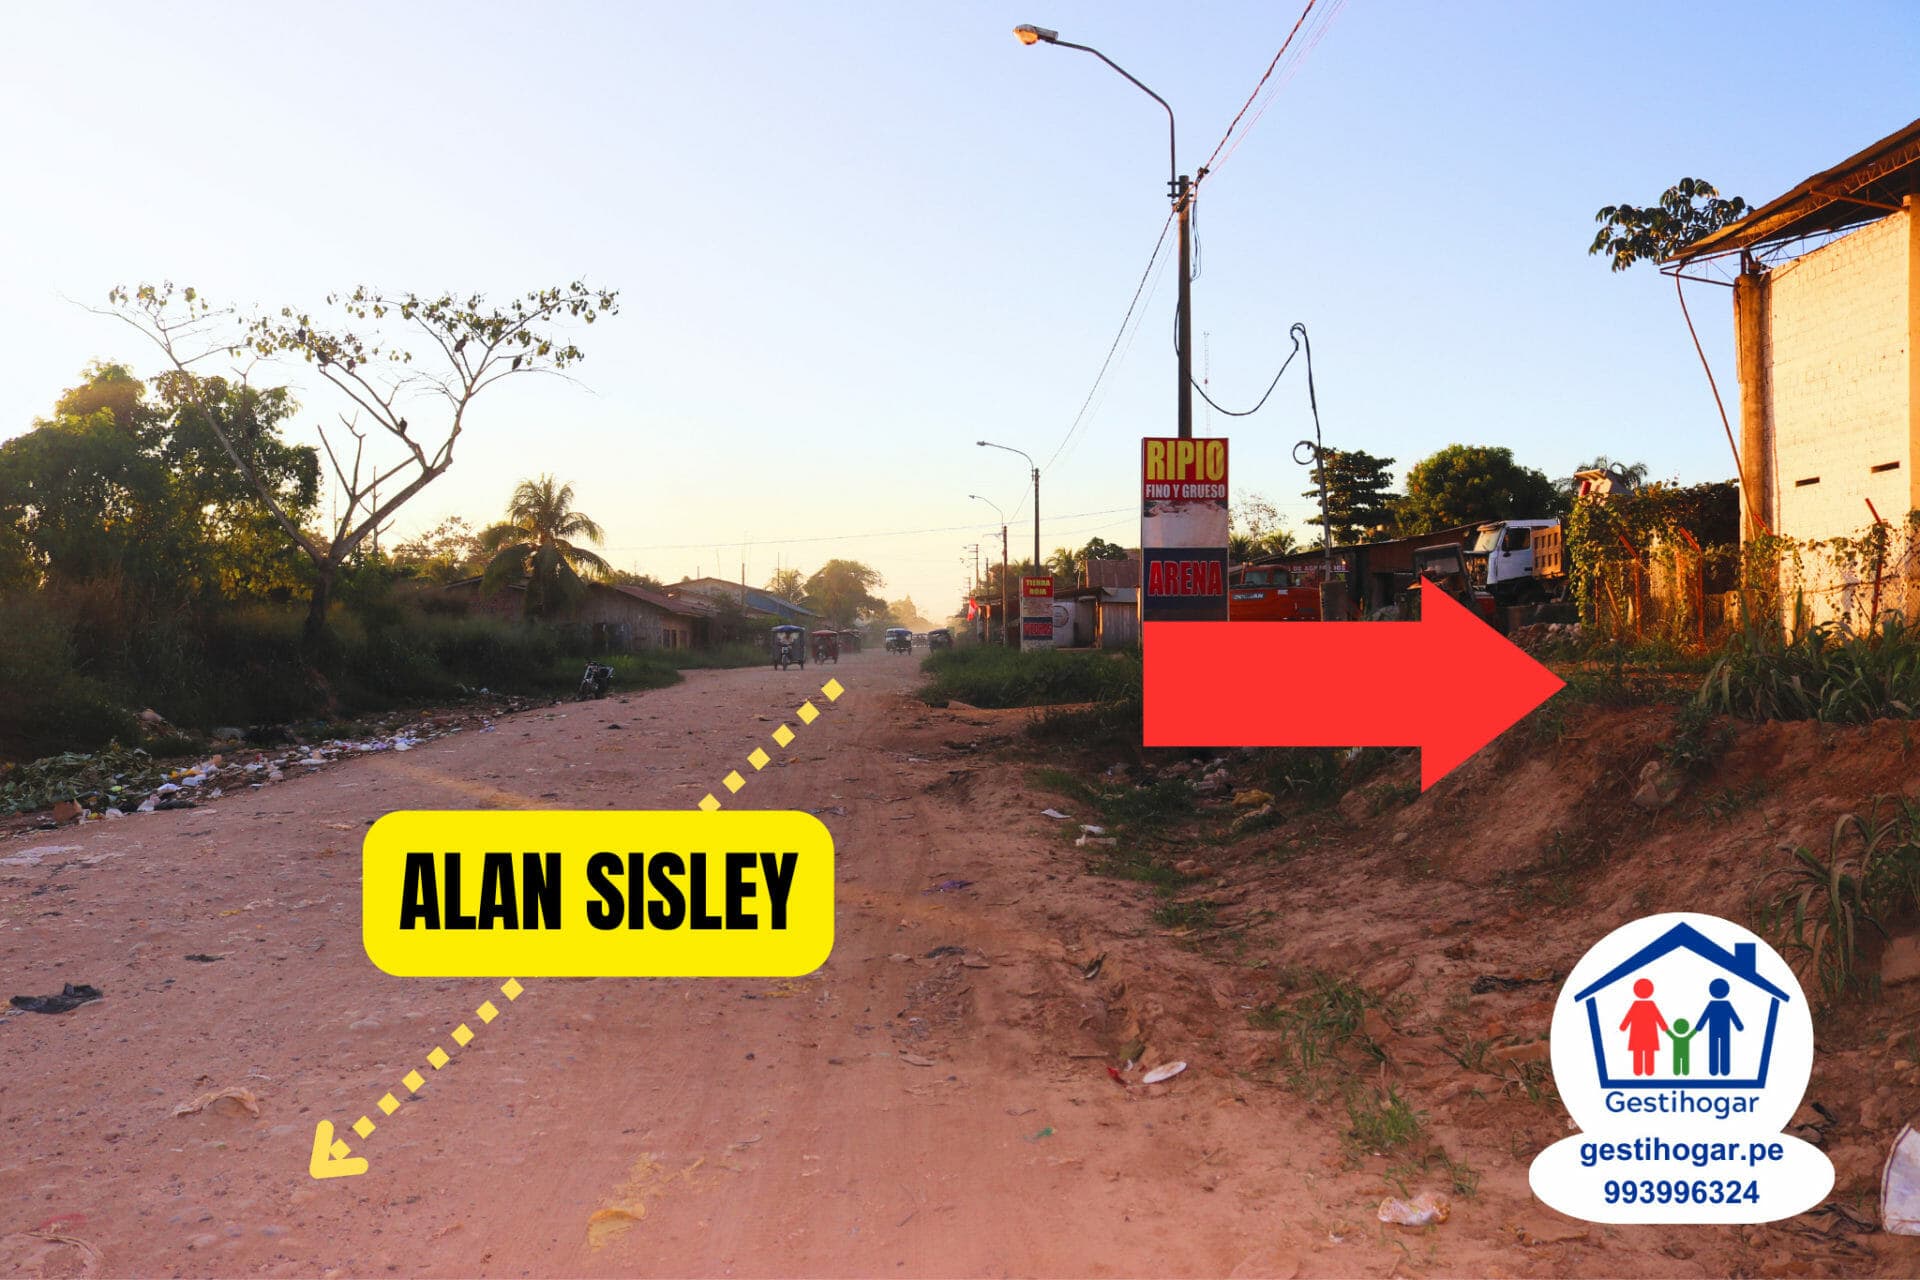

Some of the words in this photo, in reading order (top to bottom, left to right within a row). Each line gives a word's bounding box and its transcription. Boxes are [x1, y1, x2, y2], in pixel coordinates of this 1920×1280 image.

[1147, 440, 1225, 481] RIPIO
[1146, 484, 1171, 498] FINO
[1172, 484, 1180, 498] Y
[1182, 483, 1225, 498] GRUESO
[1148, 560, 1223, 597] ARENA
